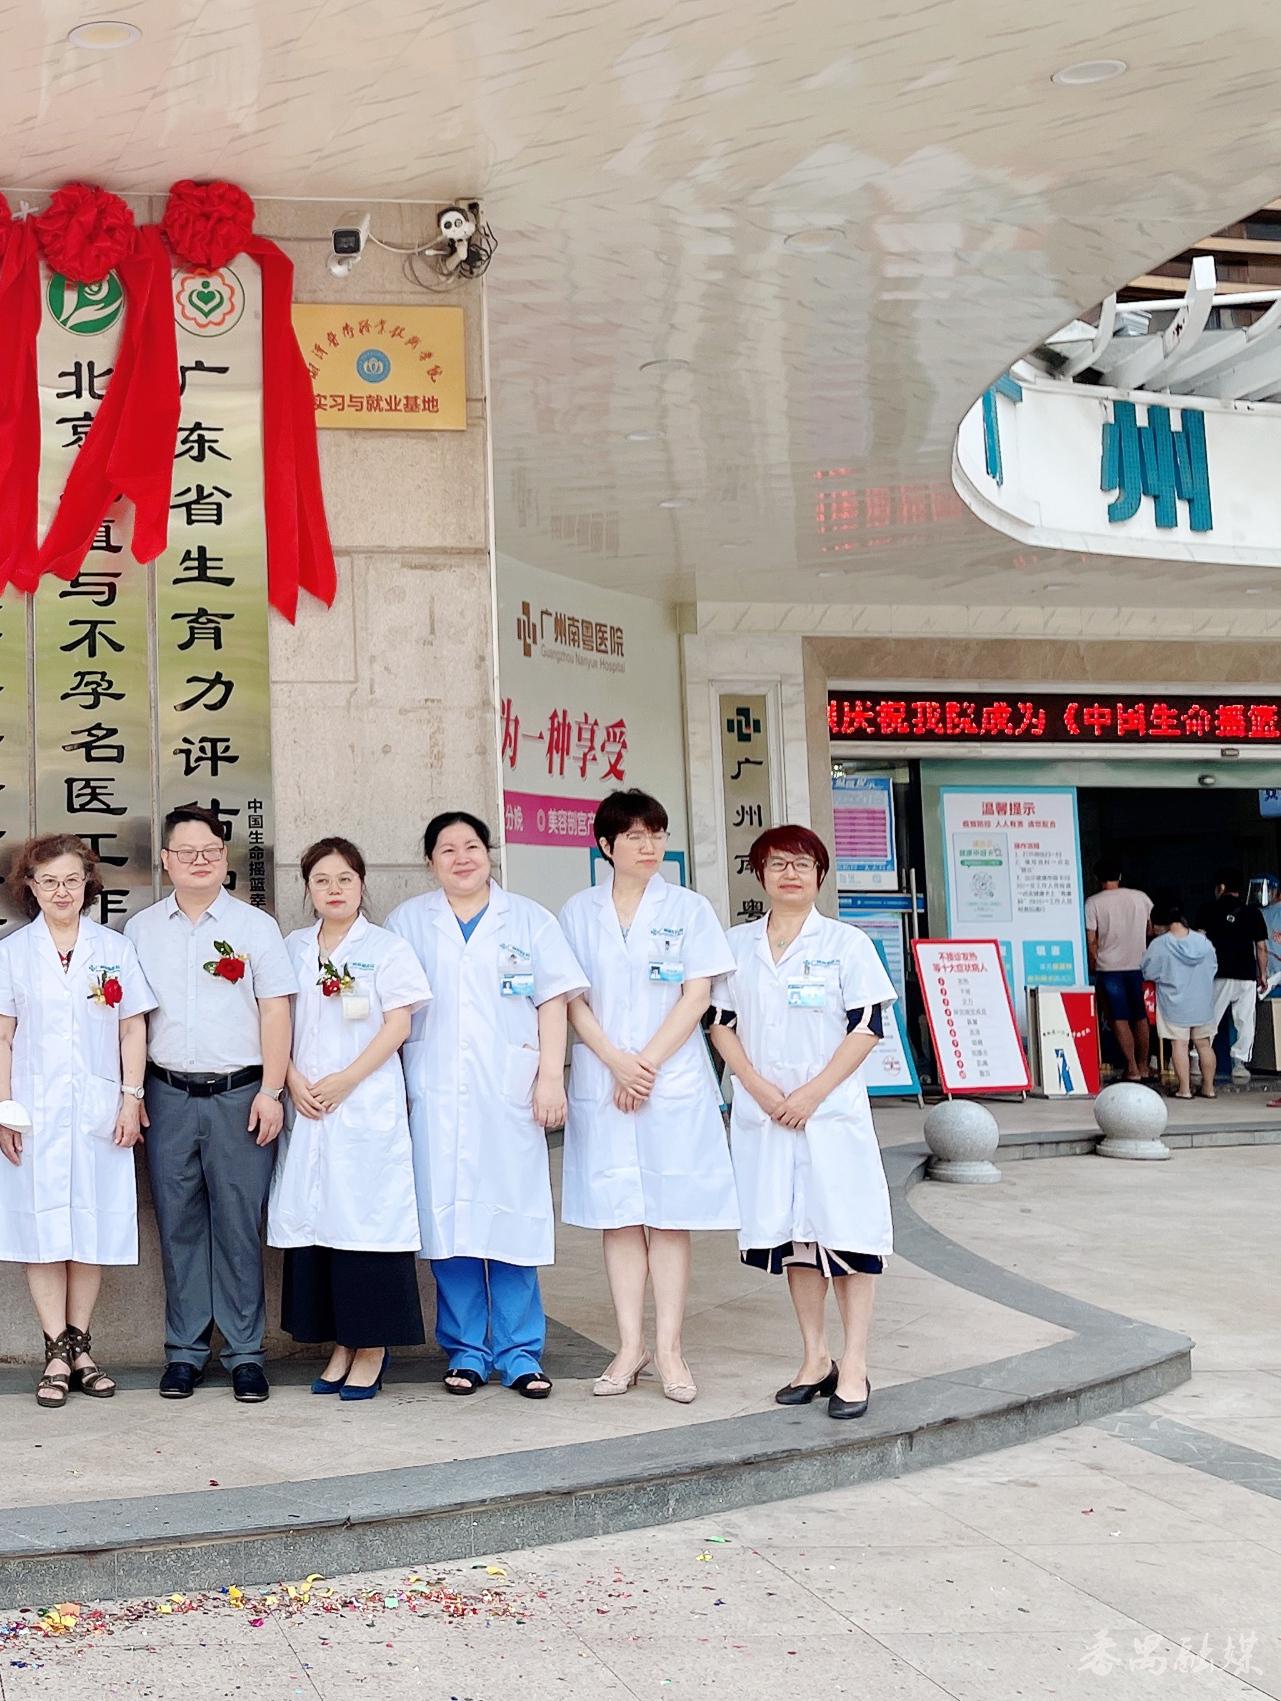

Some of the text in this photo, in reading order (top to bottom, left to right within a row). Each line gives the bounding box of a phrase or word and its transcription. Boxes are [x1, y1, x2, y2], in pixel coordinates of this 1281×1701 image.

[315, 394, 439, 413] 实习与就业基地
[169, 360, 241, 891] 广东省生育力评
[540, 608, 624, 657] 广州南粤医院
[501, 698, 628, 781] 为一种享受
